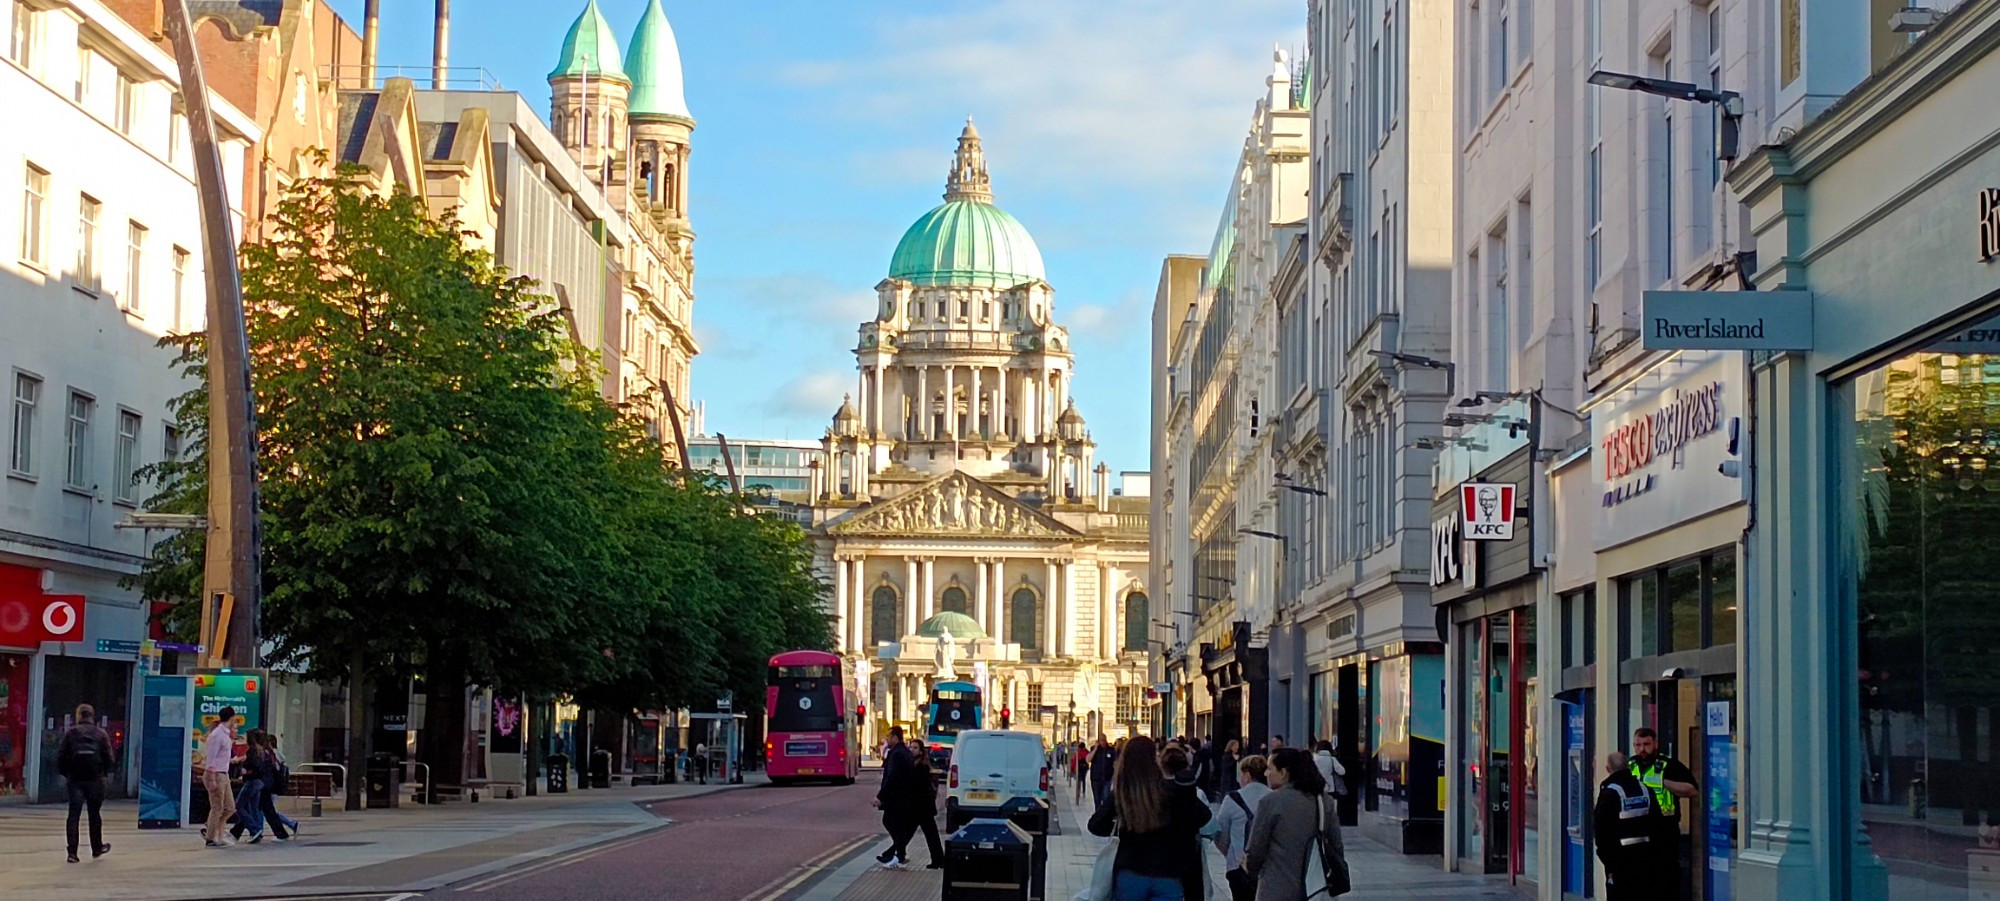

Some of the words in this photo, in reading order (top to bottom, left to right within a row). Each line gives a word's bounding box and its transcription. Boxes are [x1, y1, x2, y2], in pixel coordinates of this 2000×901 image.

[1977, 188, 2000, 262] Ri
[1602, 413, 1653, 481] TESCO
[1655, 381, 1719, 470] express
[1430, 510, 1458, 587] KFC
[1473, 524, 1505, 535] KFC
[200, 702, 248, 714] Chien
[383, 714, 407, 722] NEXT
